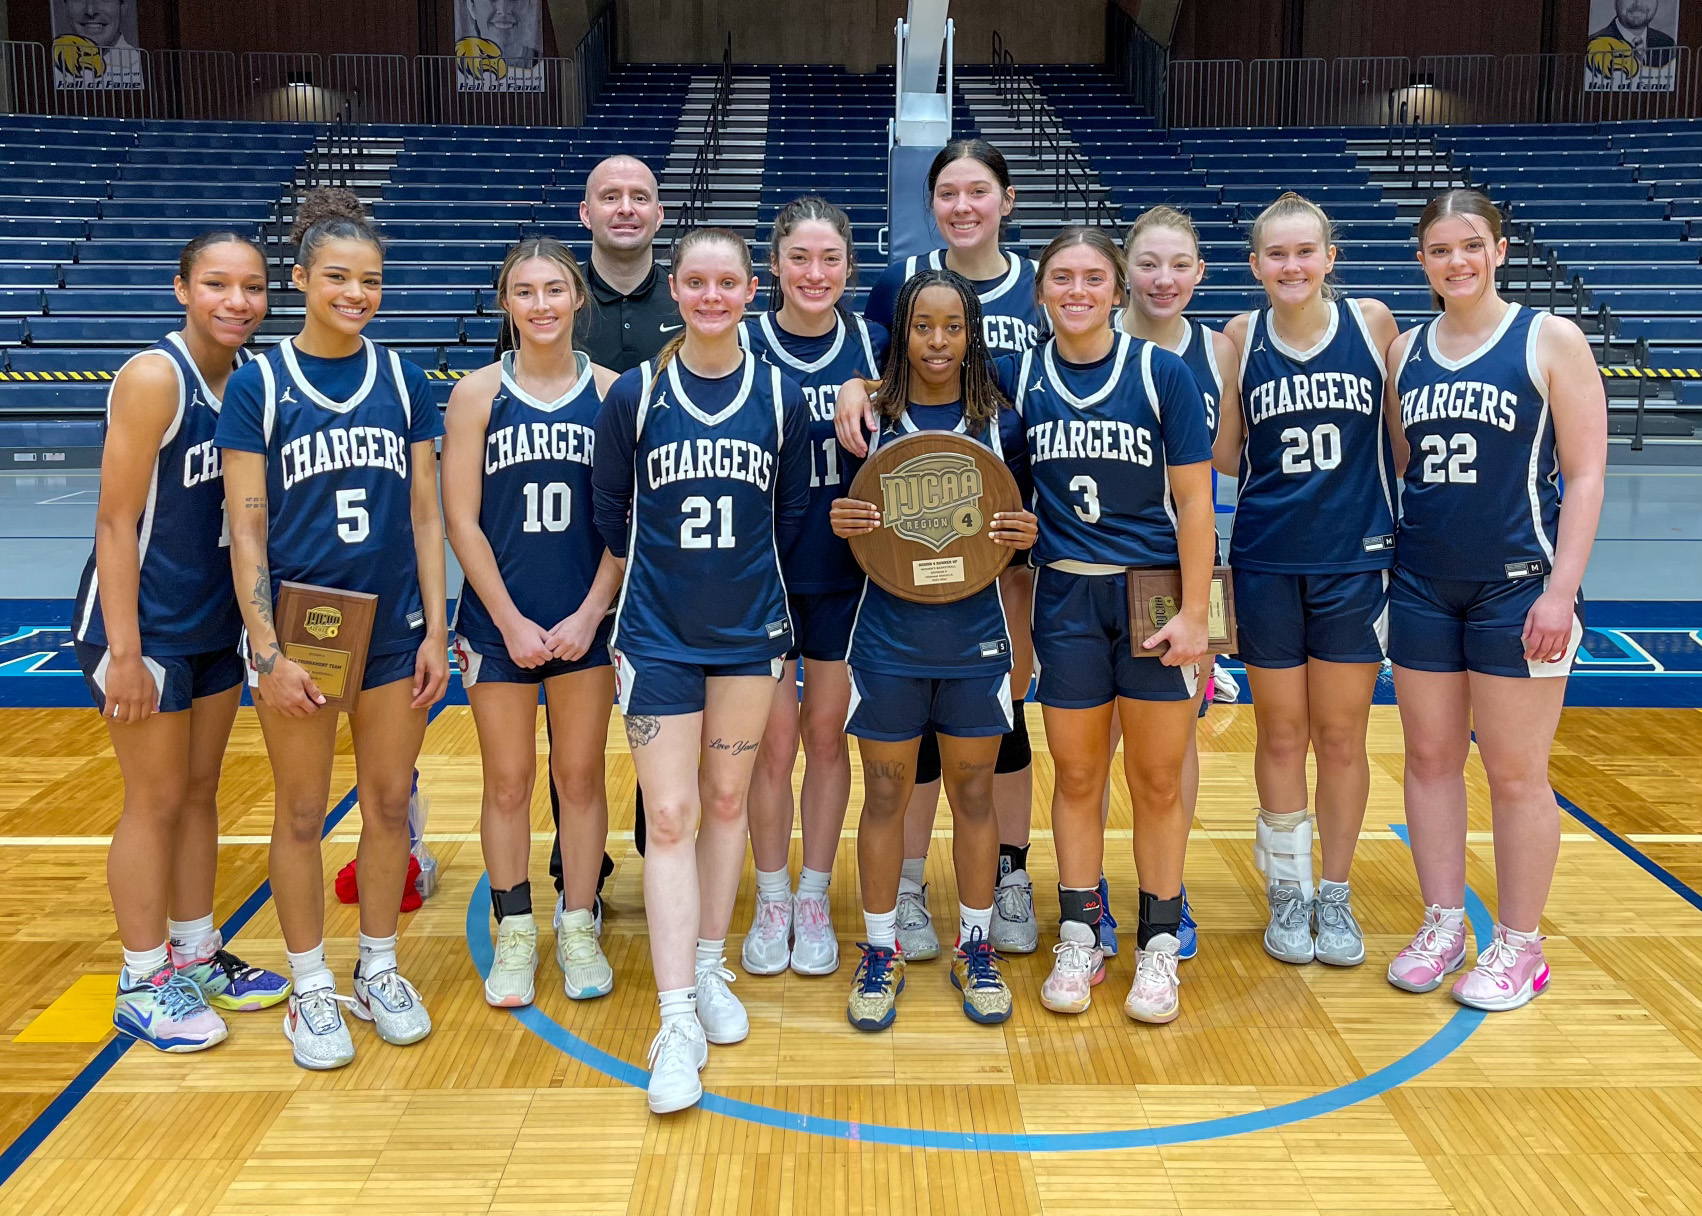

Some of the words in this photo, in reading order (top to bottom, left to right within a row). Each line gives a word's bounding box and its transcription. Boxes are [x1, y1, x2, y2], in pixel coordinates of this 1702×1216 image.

[57, 80, 84, 89] Hall
[87, 80, 101, 89] of
[105, 80, 141, 89] Fame
[459, 82, 485, 91] Hall
[488, 83, 504, 91] of
[507, 82, 541, 91] Fame
[1588, 81, 1613, 90] Hall
[1617, 81, 1632, 90] of
[1636, 81, 1671, 90] Fame
[982, 314, 1038, 353] GERS
[1249, 372, 1373, 425] CHARGERS
[1401, 381, 1518, 432] HARGERS
[281, 426, 407, 491] CHARGERS
[485, 422, 596, 475] CHARGER
[646, 438, 773, 491] CHARGERS
[1026, 419, 1153, 467] CHARGERS
[1280, 423, 1342, 474] 20
[1420, 433, 1477, 483] 22
[335, 488, 370, 543] 5
[523, 482, 572, 532] 10
[885, 471, 978, 521] NJCAA
[1069, 475, 1101, 523] 3
[680, 496, 736, 549] 21
[906, 518, 948, 530] REGION
[961, 513, 973, 528] 4
[1000, 642, 1005, 650] S
[709, 737, 731, 750] Love
